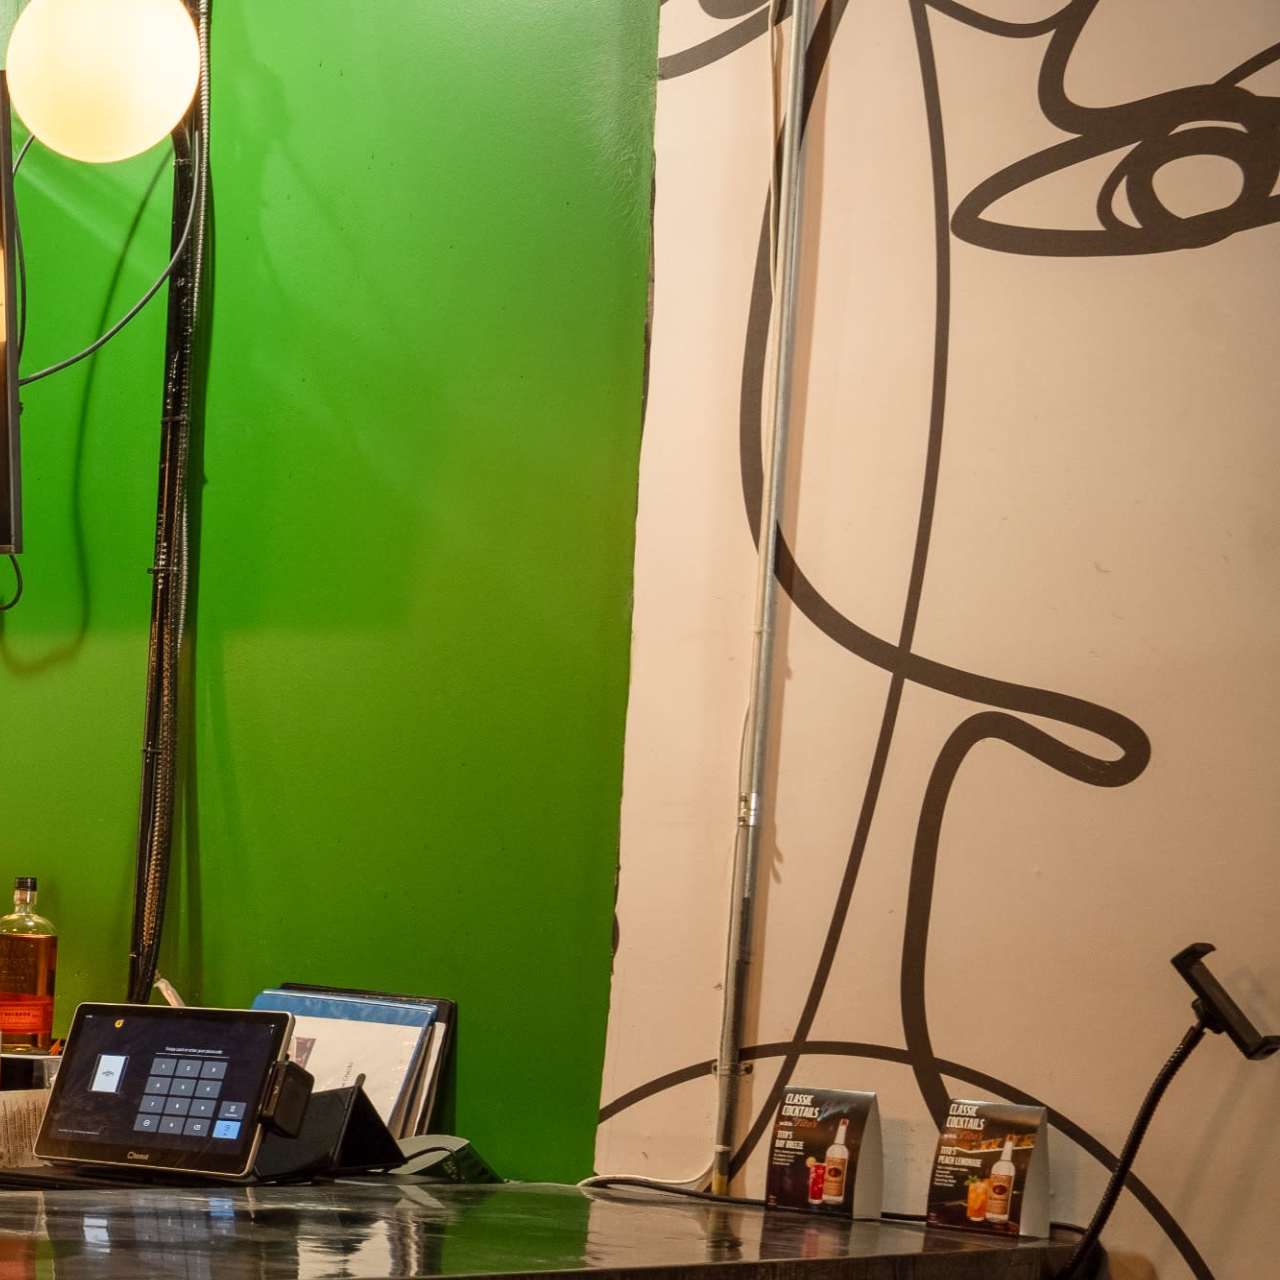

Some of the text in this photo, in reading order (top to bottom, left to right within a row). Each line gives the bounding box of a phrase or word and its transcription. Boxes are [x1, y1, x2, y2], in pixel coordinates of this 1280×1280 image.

[785, 1093, 815, 1106] CLASSIC
[781, 1105, 820, 1119] COCKTAILS
[949, 1103, 979, 1117] CLASSIC
[946, 1116, 985, 1131] COCKTAILS
